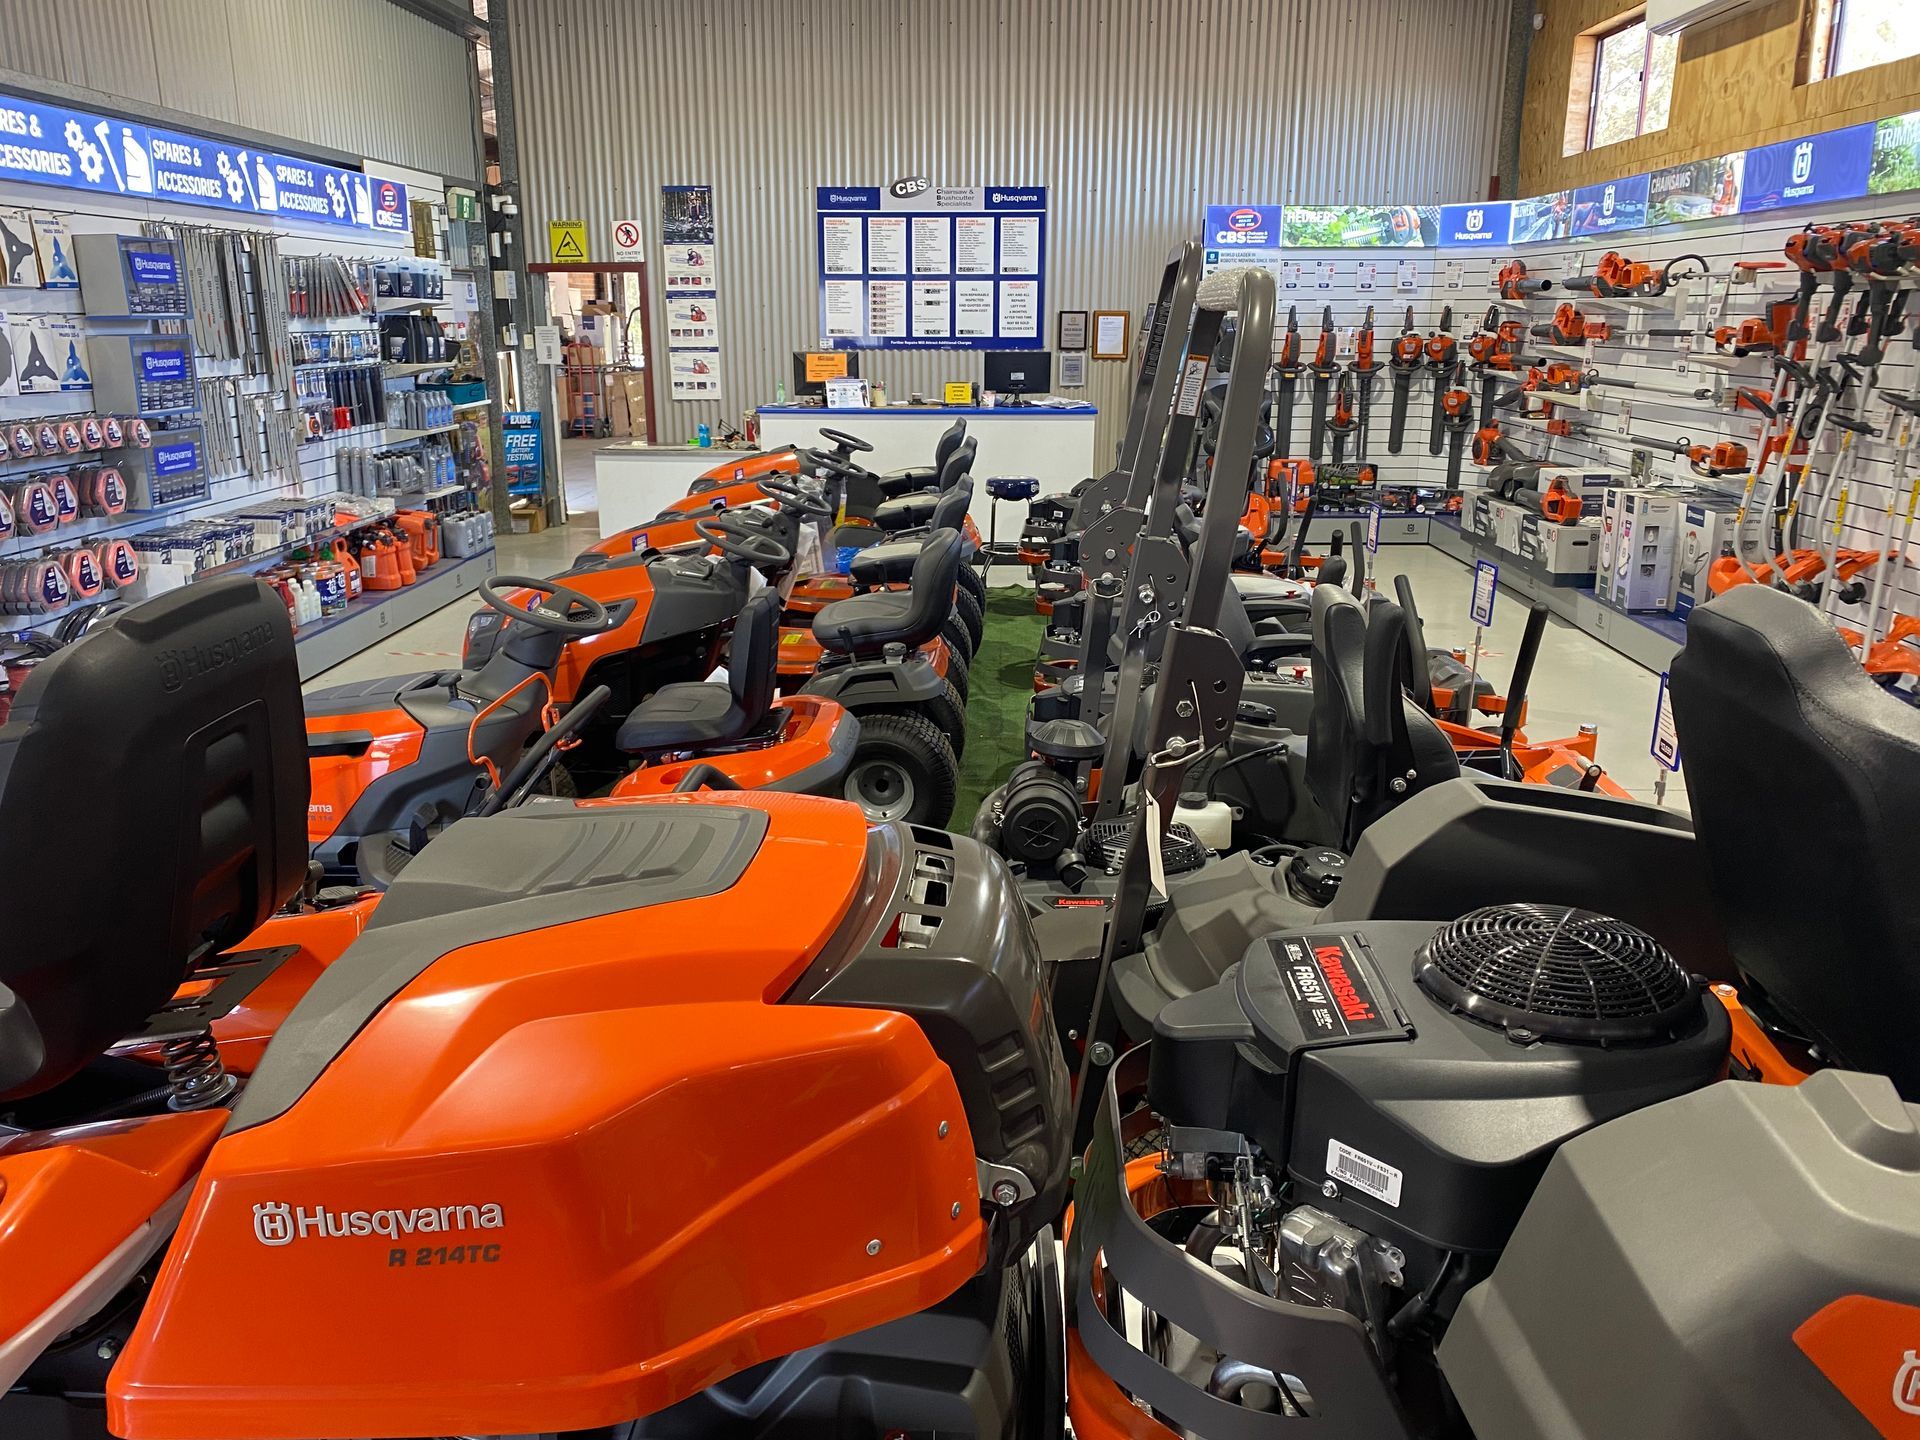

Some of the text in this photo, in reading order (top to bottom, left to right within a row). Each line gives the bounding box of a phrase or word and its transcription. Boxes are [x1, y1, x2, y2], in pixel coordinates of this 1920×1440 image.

[29, 114, 43, 138] &
[152, 139, 202, 168] SPARES &
[157, 170, 222, 199] ACCESSORIES
[276, 164, 314, 188] SPARES &
[1651, 171, 1691, 194] CHAINSAWS
[895, 178, 927, 195] CBS
[1783, 184, 1815, 199] Husqvarna
[279, 190, 329, 215] ACCESSORIES
[1000, 194, 1037, 203] Husqvarna
[1216, 231, 1246, 244] CBS
[1454, 232, 1493, 241] Husqvarna
[142, 259, 171, 271] Husqvarna
[153, 357, 181, 369] Husqvarna
[510, 414, 532, 424] EXIDE
[505, 434, 538, 448] FREE
[164, 450, 192, 462] Husqvarna
[506, 453, 534, 462] TESTING
[1293, 966, 1327, 1004] FR651V
[1314, 946, 1375, 1021] Kawasaki
[299, 1202, 504, 1240] Husqvarna
[387, 1244, 501, 1268] R 214TC
